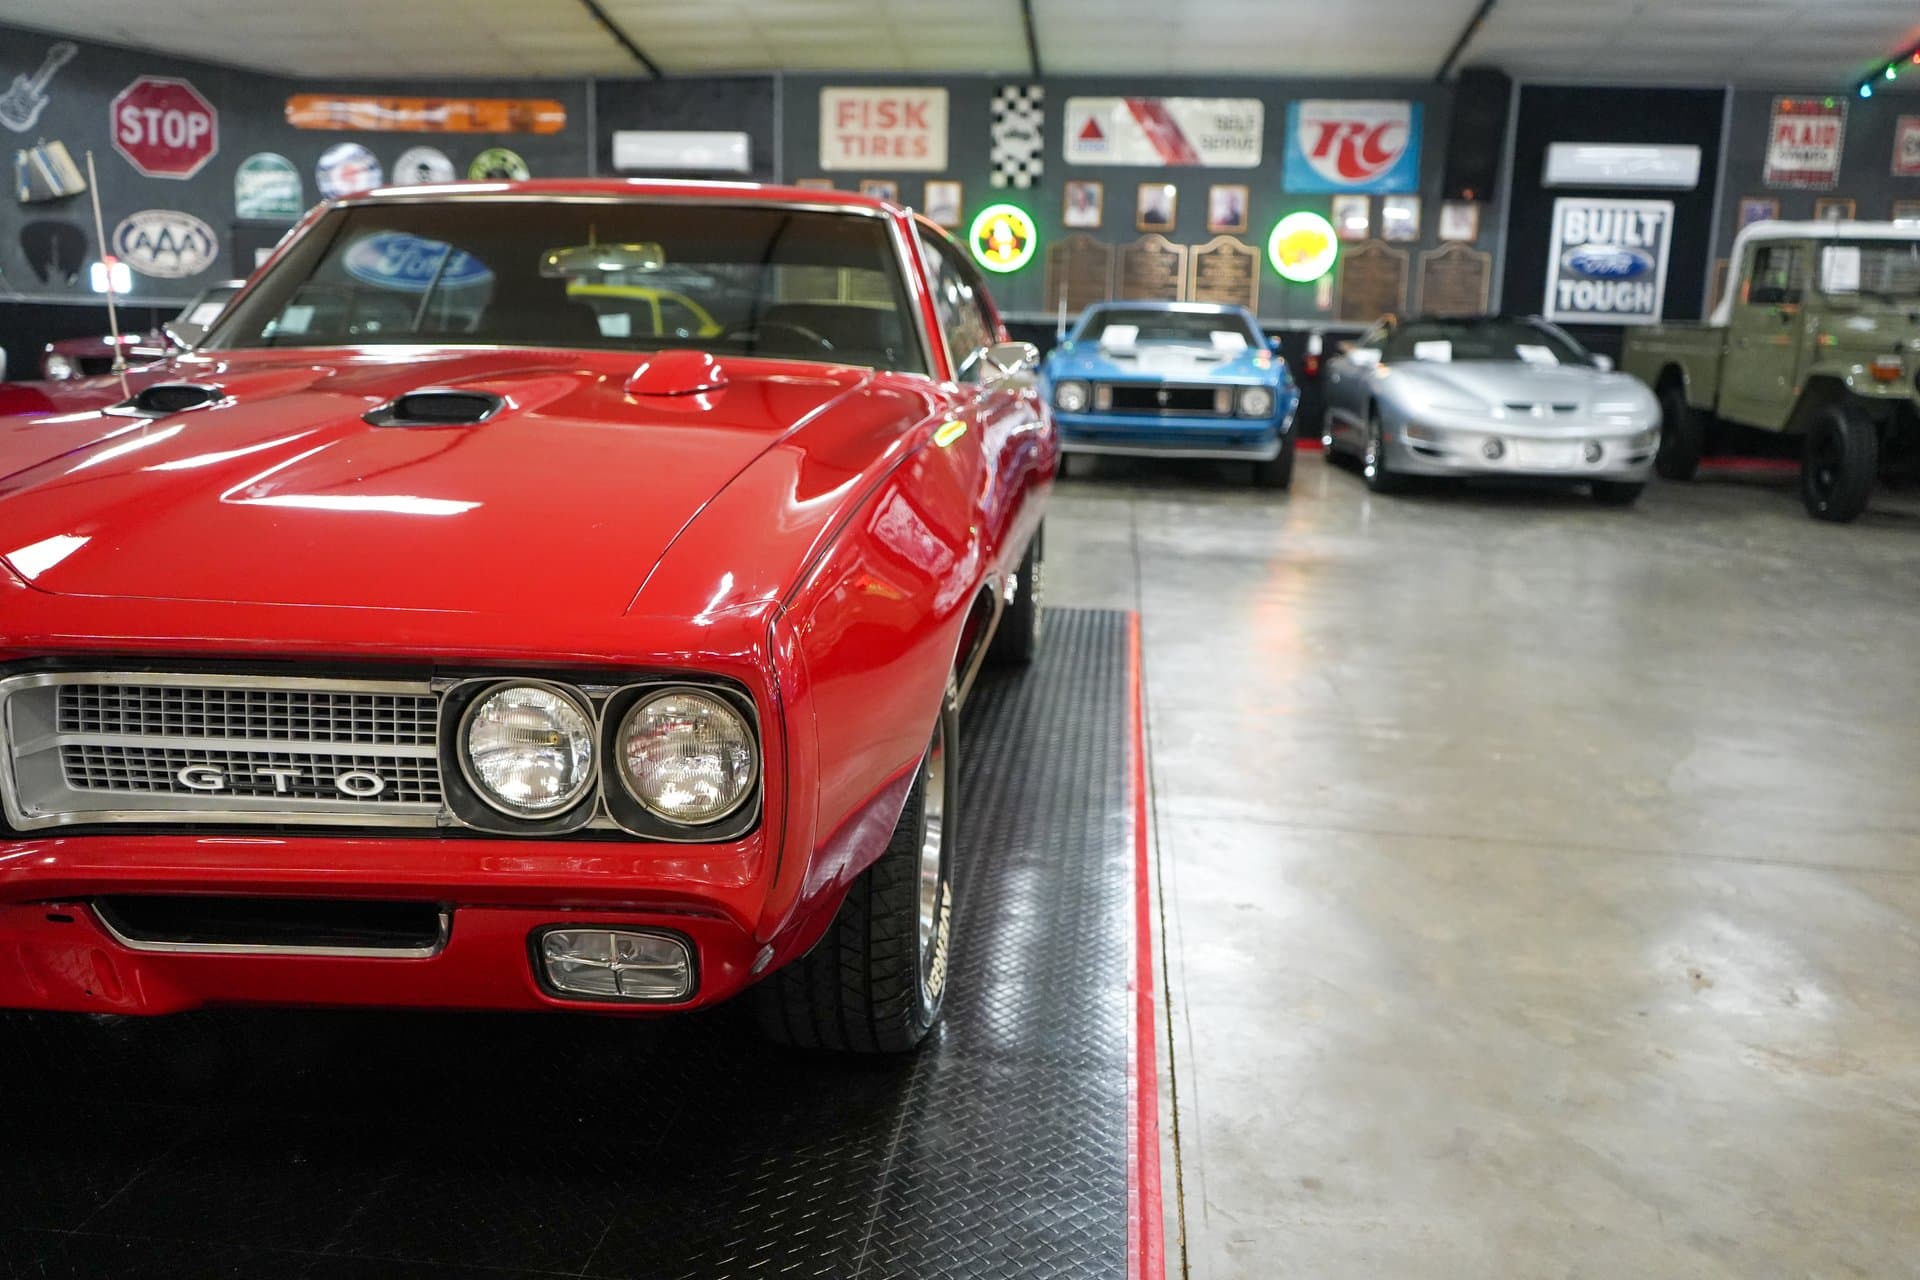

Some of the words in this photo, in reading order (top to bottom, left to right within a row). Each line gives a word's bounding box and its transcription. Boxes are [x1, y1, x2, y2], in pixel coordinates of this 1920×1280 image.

[120, 105, 209, 149] STOP
[836, 100, 929, 129] FISK
[839, 135, 929, 157] TIRES
[1304, 120, 1405, 178] RC
[135, 227, 195, 263] AAA
[1563, 210, 1664, 247] BUILT
[1557, 280, 1654, 313] TOUGH
[177, 764, 384, 797] GTO
